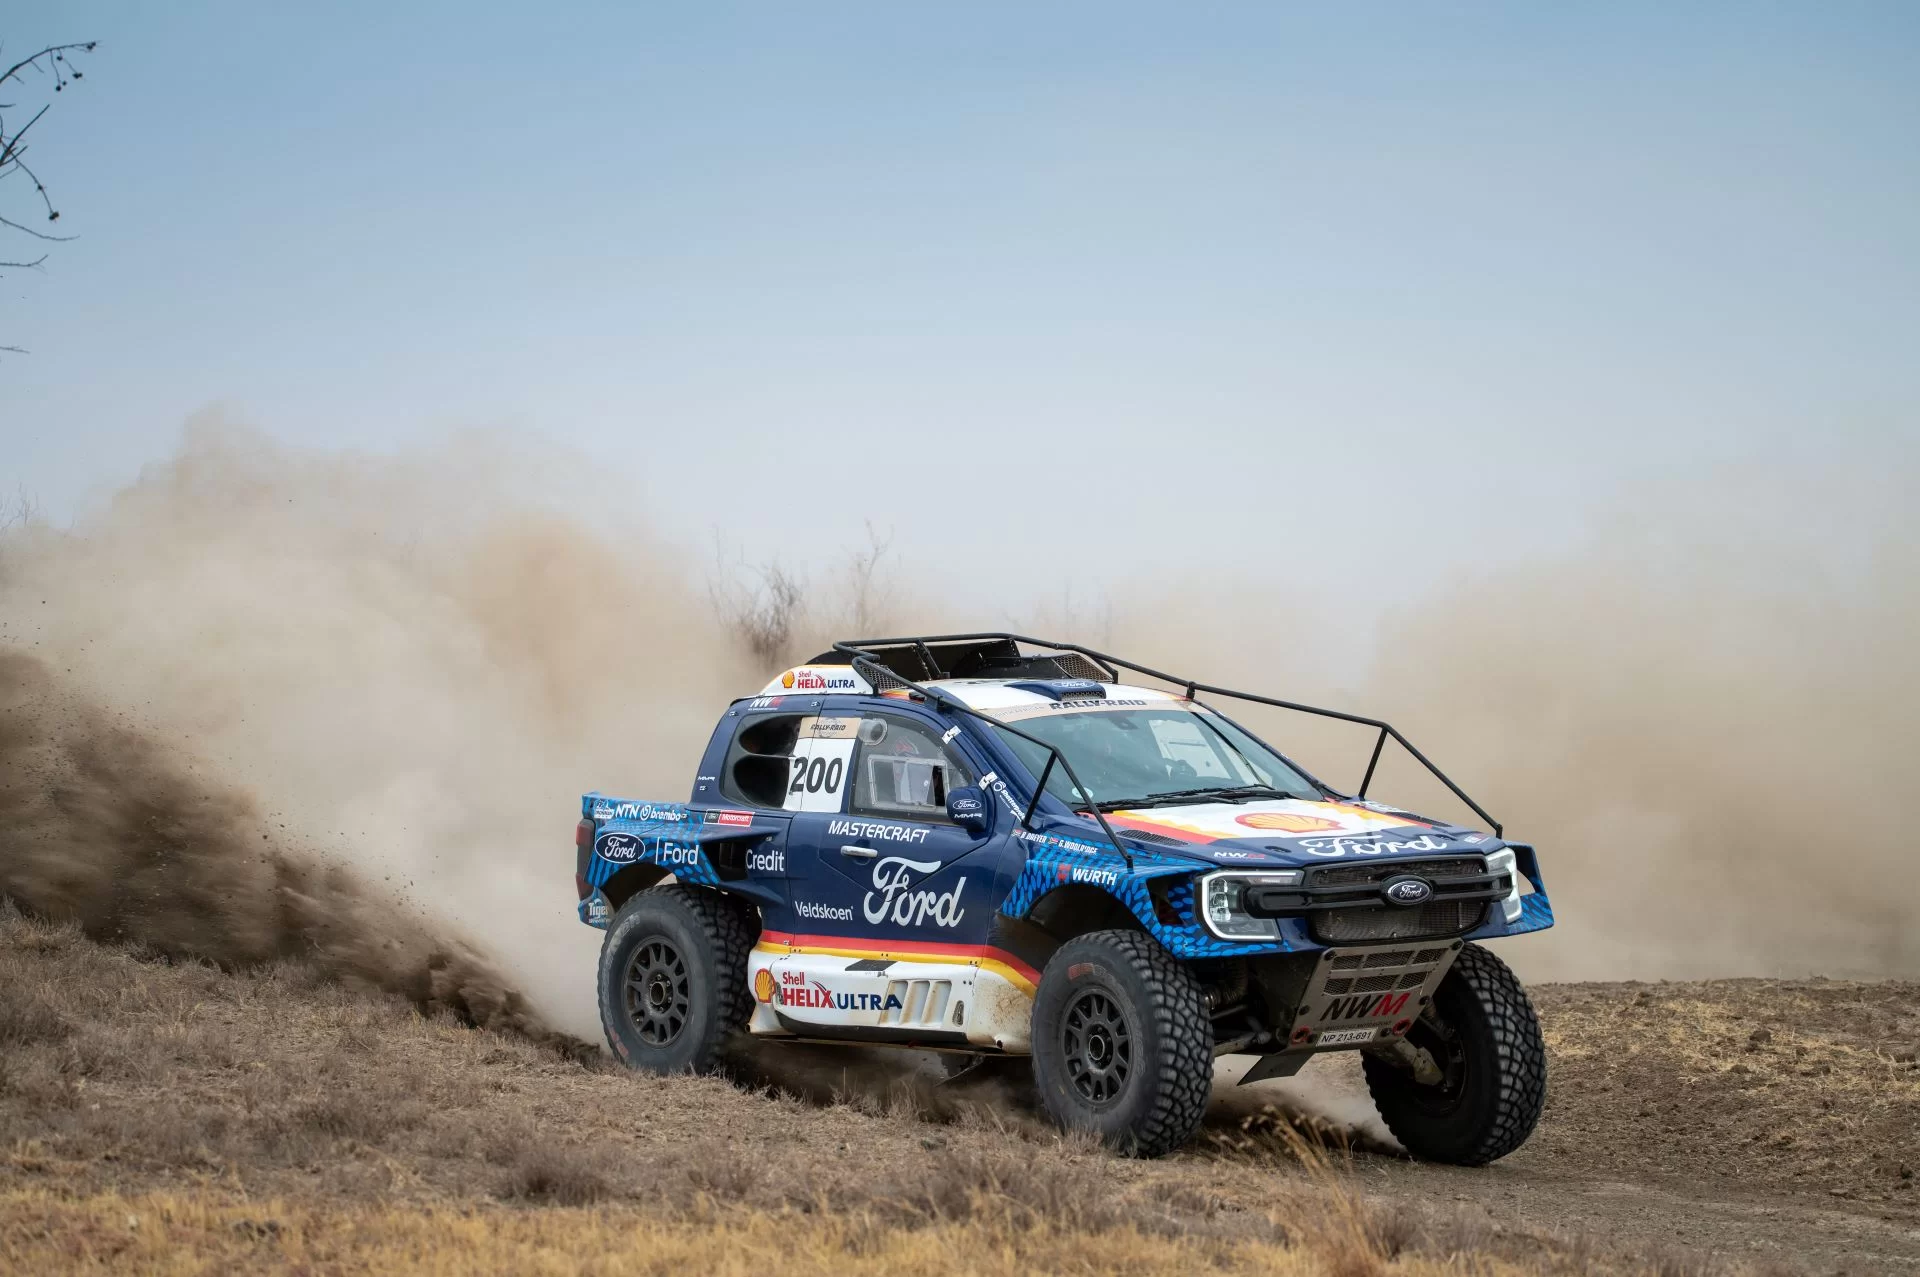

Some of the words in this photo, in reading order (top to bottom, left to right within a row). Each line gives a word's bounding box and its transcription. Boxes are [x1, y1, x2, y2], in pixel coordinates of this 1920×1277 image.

[797, 678, 826, 689] HELIX
[827, 679, 856, 688] ULTRA
[798, 670, 812, 678] Shell
[1049, 700, 1147, 710] RALLY-RAID
[789, 756, 843, 794] 200
[615, 803, 641, 819] NTN
[650, 807, 682, 821] brembo
[828, 820, 930, 844] MASTERCRAFT
[604, 836, 637, 859] Ford
[1297, 835, 1449, 857] Ford
[663, 842, 700, 865] Ford
[745, 849, 785, 872] Credit
[1072, 867, 1118, 886] WÜRTH
[863, 856, 967, 928] Ford
[1399, 884, 1423, 899] Ford
[794, 900, 854, 922] Veldskoen
[782, 971, 805, 986] Shell
[782, 987, 836, 1009] HELIX
[836, 993, 903, 1011] ULTRA
[1319, 992, 1412, 1021] NWM
[1321, 1034, 1336, 1043] NP
[1337, 1031, 1373, 1042] 213-691
